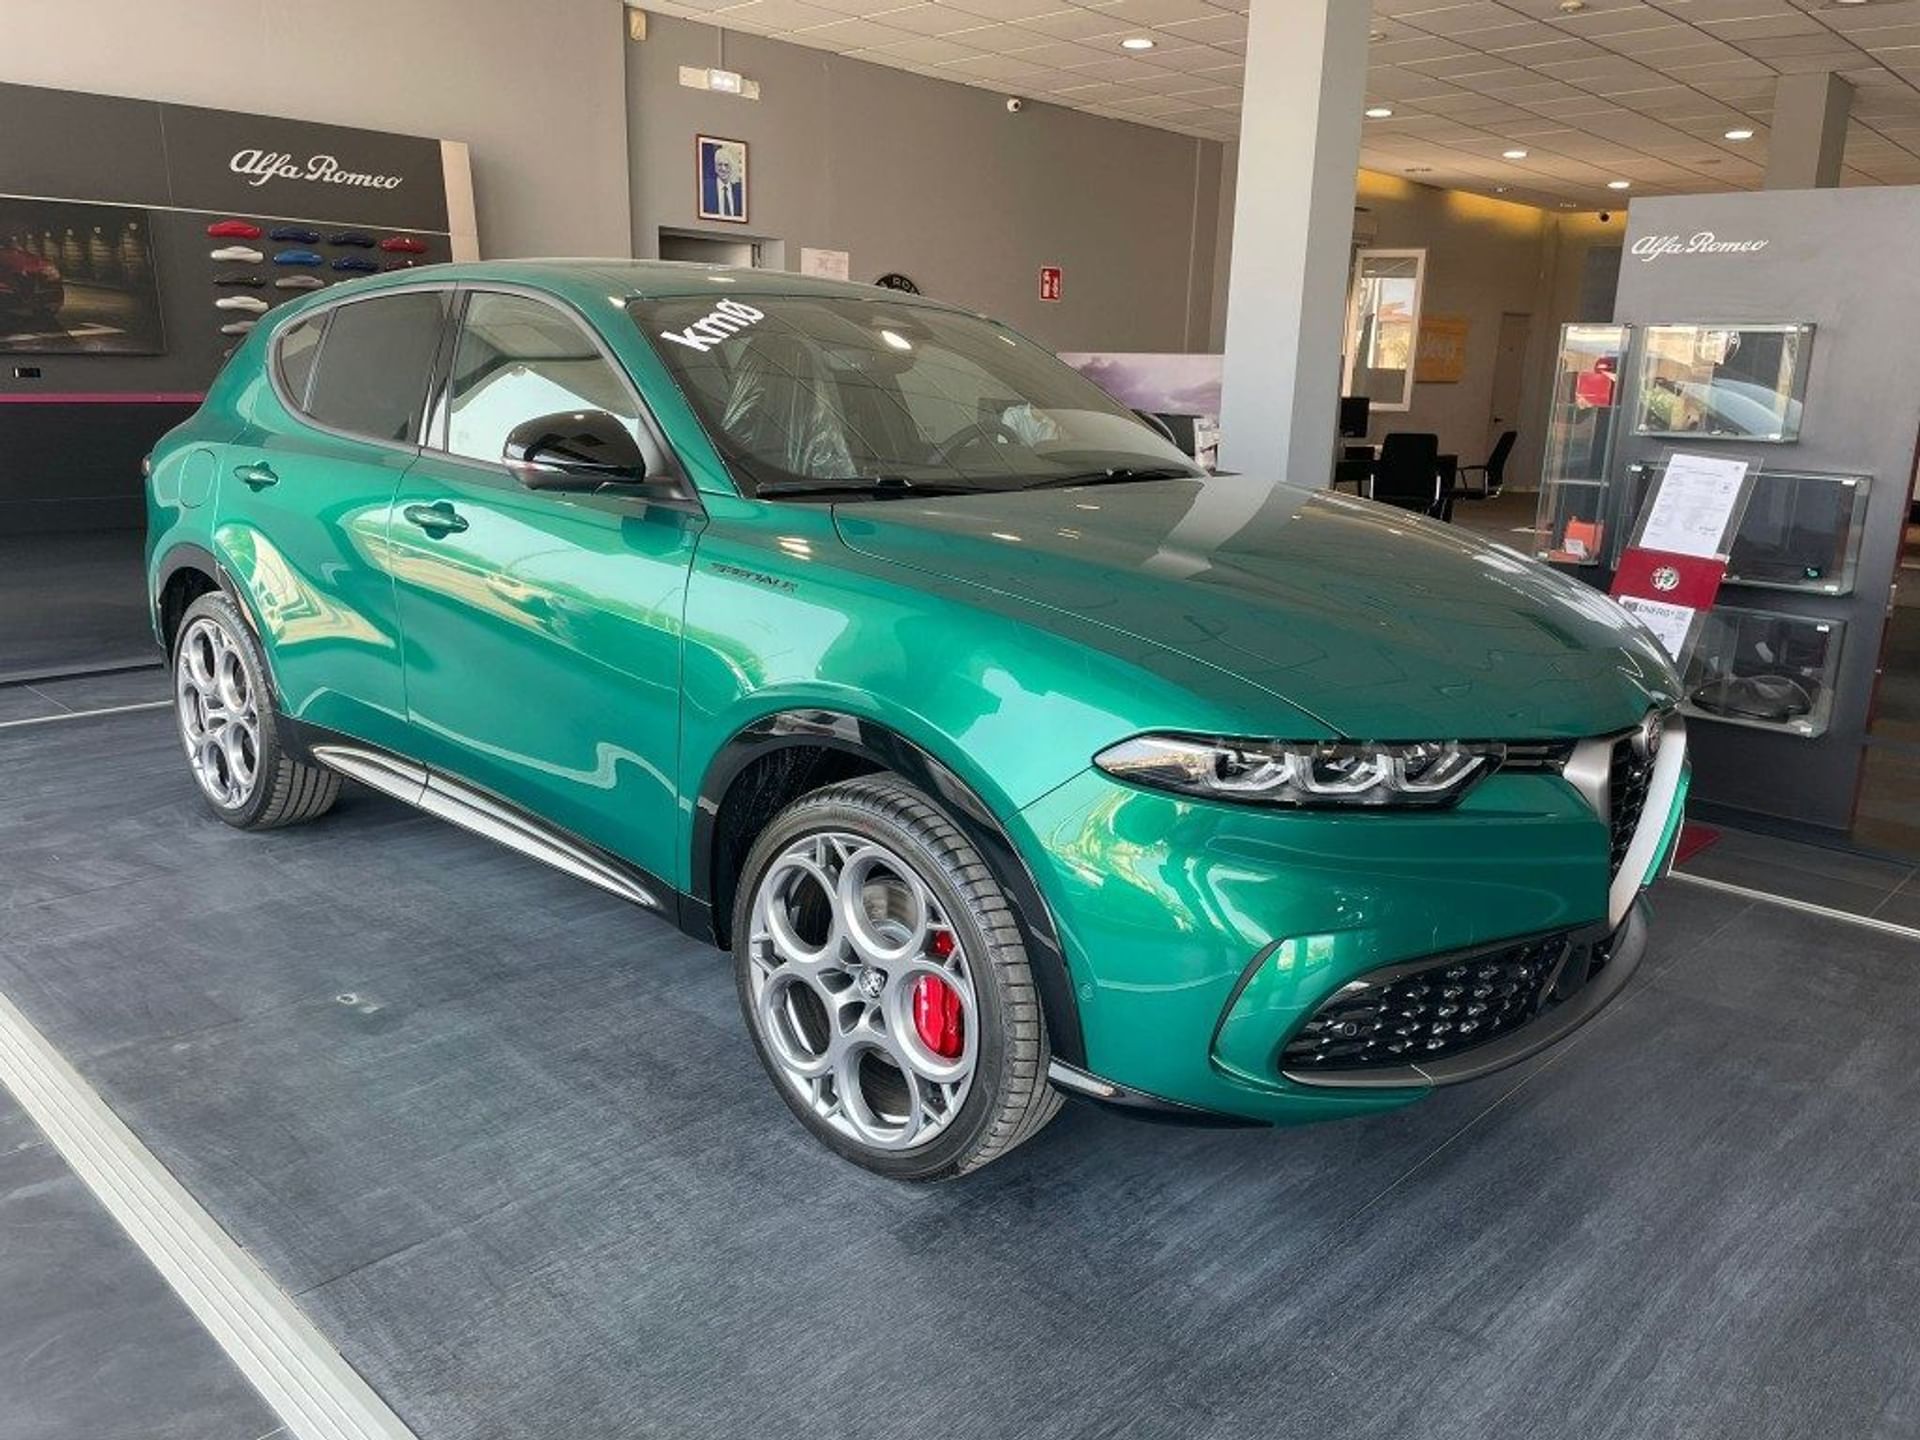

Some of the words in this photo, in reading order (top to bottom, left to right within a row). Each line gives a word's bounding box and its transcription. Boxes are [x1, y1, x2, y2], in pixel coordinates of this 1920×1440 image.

[230, 149, 303, 186] Alfa
[304, 155, 402, 189] Romeo
[1631, 235, 1683, 262] Alfa
[1685, 231, 1768, 254] Romeo
